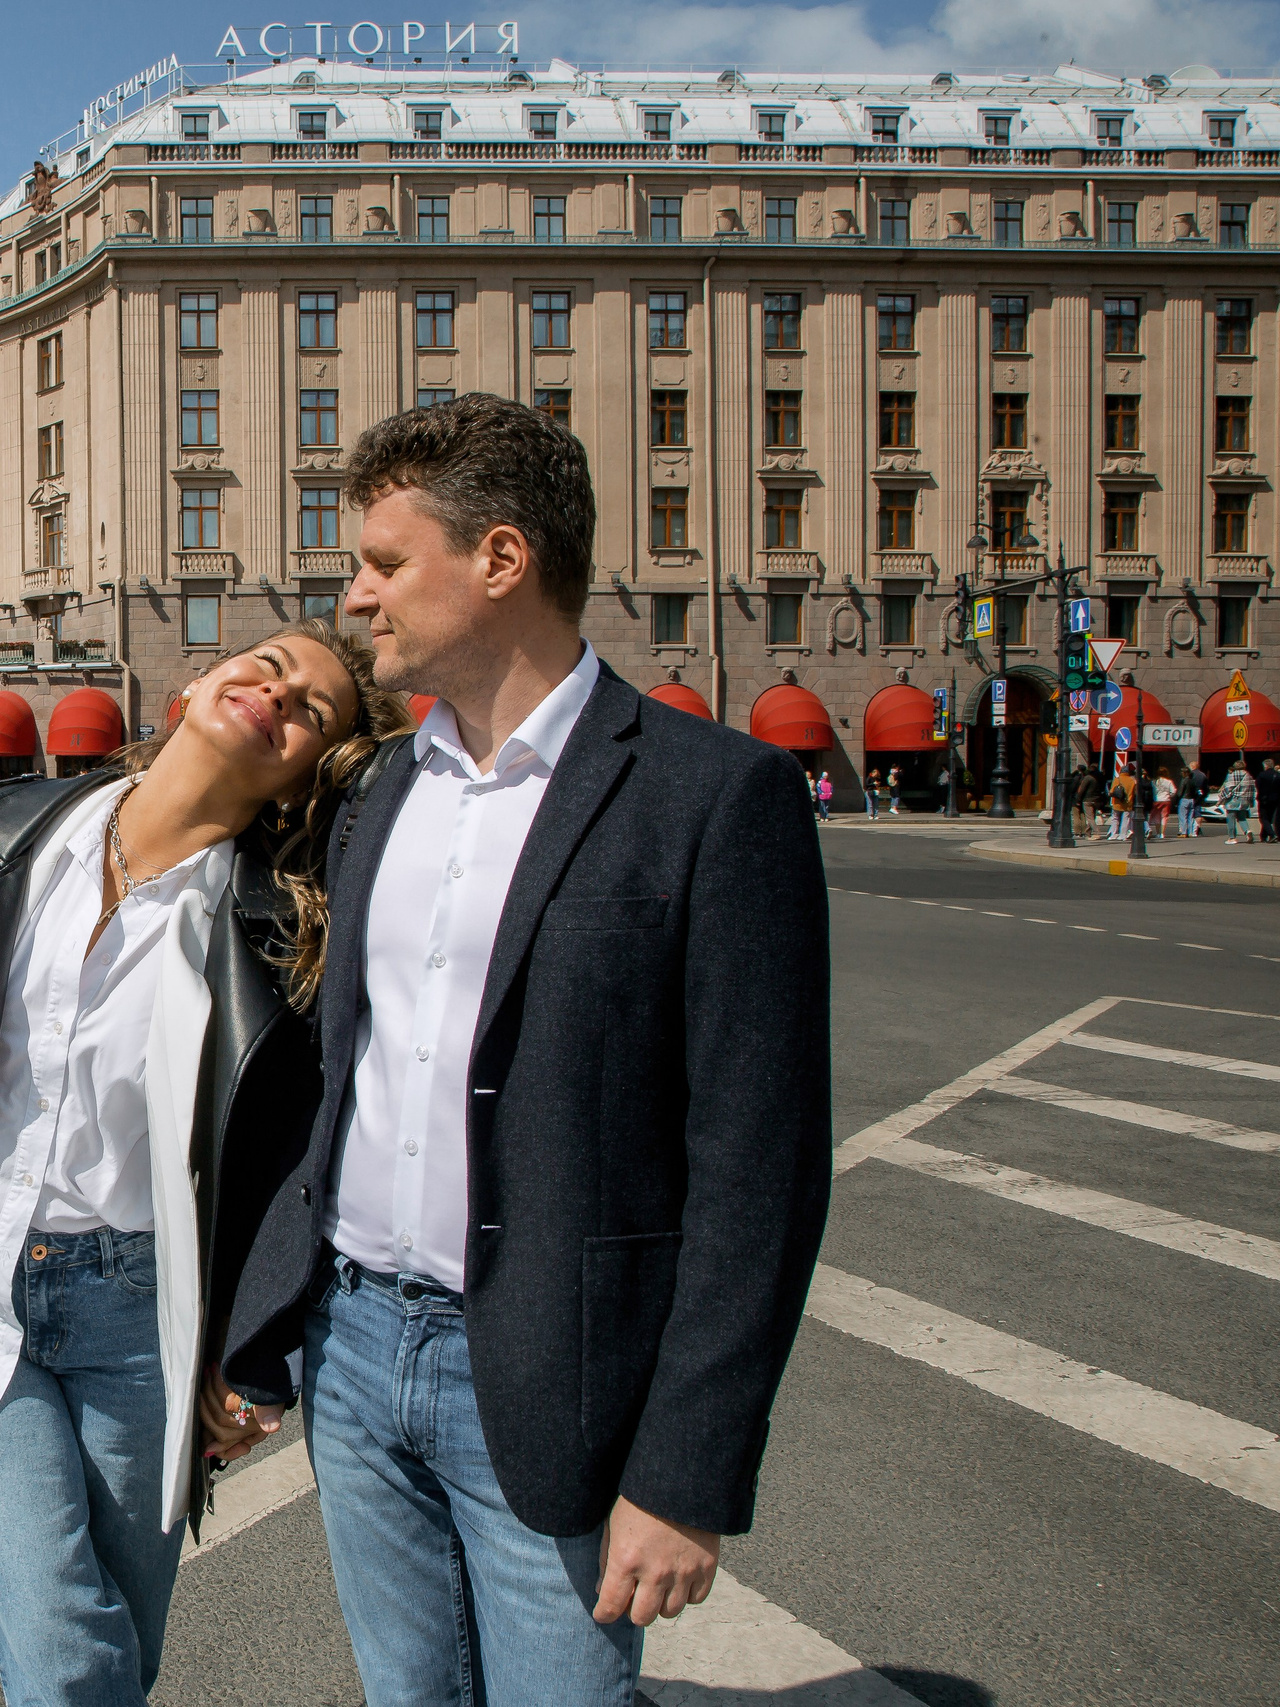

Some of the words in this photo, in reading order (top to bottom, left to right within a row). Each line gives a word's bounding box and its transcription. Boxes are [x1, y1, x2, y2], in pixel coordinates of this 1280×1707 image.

[215, 21, 519, 57] АСТОРИЯ
[89, 53, 179, 126] ГОСТИНИЦА
[1068, 656, 1082, 667] 01
[1151, 728, 1193, 742] СТОП
[1235, 728, 1245, 739] 40
